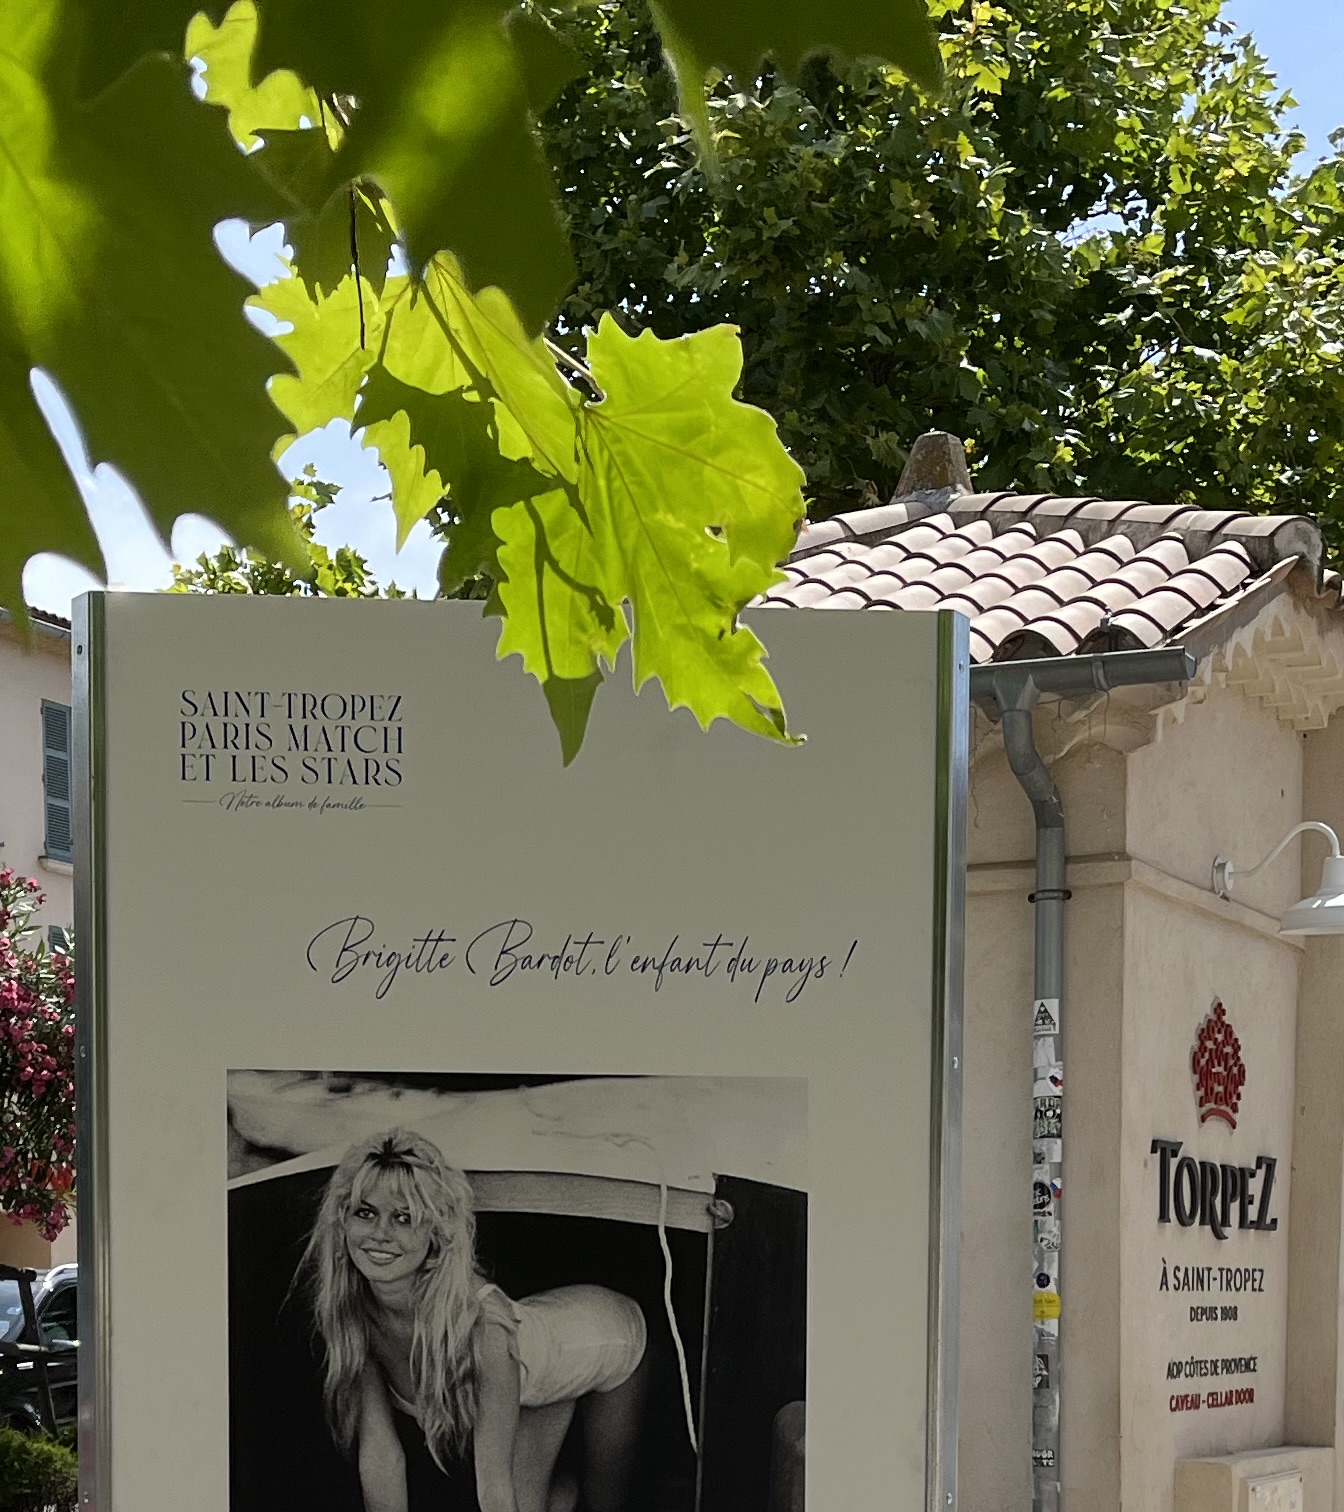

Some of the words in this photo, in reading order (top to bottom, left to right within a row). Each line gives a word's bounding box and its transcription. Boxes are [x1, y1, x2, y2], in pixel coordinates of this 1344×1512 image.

[180, 689, 404, 723] SAINT-TROPEZ
[180, 720, 274, 751] PARIS
[287, 723, 404, 754] MATCH
[180, 753, 217, 782] ET
[230, 754, 289, 784] LES
[301, 756, 404, 787] STARS
[219, 789, 262, 812] Notre
[320, 796, 367, 815] famille
[306, 915, 456, 999] Brigitte
[465, 918, 605, 986] Bardot,
[726, 935, 758, 981] du
[755, 955, 834, 1003] pays
[1150, 1138, 1278, 1240] TORPEZ
[1159, 1257, 1170, 1292] À
[1173, 1264, 1265, 1293] SAINT-TROPEZ
[1190, 1305, 1218, 1322] DEPUIS
[1166, 1360, 1183, 1380] AOP
[1184, 1356, 1209, 1378] CÔTES
[1210, 1359, 1220, 1376] DE
[1221, 1356, 1258, 1375] PROVENCE
[1170, 1393, 1201, 1412] CAVEAU
[1207, 1390, 1234, 1409] CELLAR
[1235, 1387, 1255, 1406] DOOR
